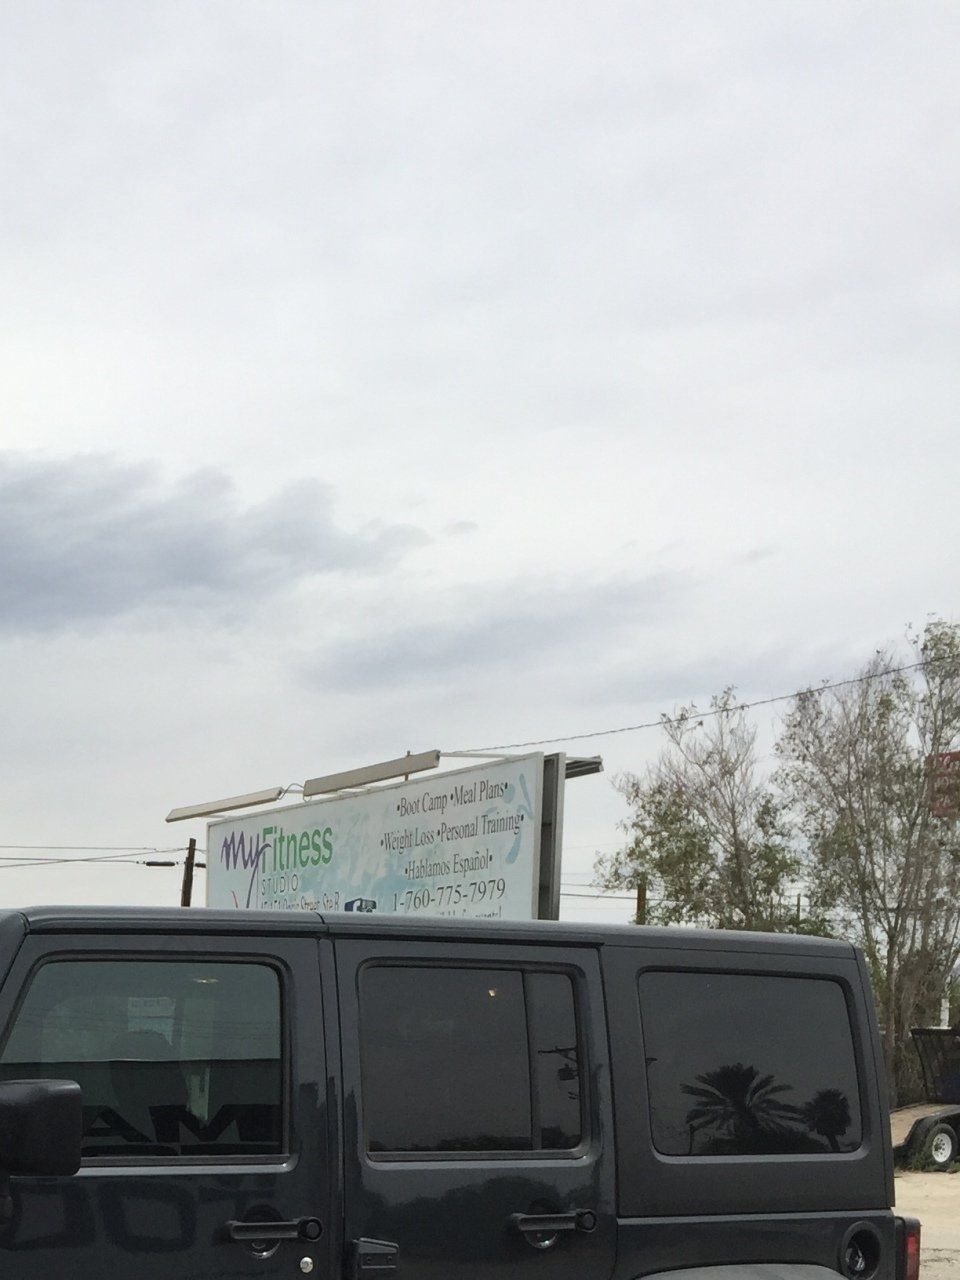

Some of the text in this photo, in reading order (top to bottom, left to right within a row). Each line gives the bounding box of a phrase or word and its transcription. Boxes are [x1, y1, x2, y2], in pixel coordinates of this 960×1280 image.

[400, 780, 504, 817] Boot Camp Meal Plans
[383, 811, 521, 854] Weight Loss Personal Training
[407, 849, 489, 880] Hablamos Español
[261, 873, 299, 896] STUDIO
[393, 878, 506, 911] 1-760-775-7979
